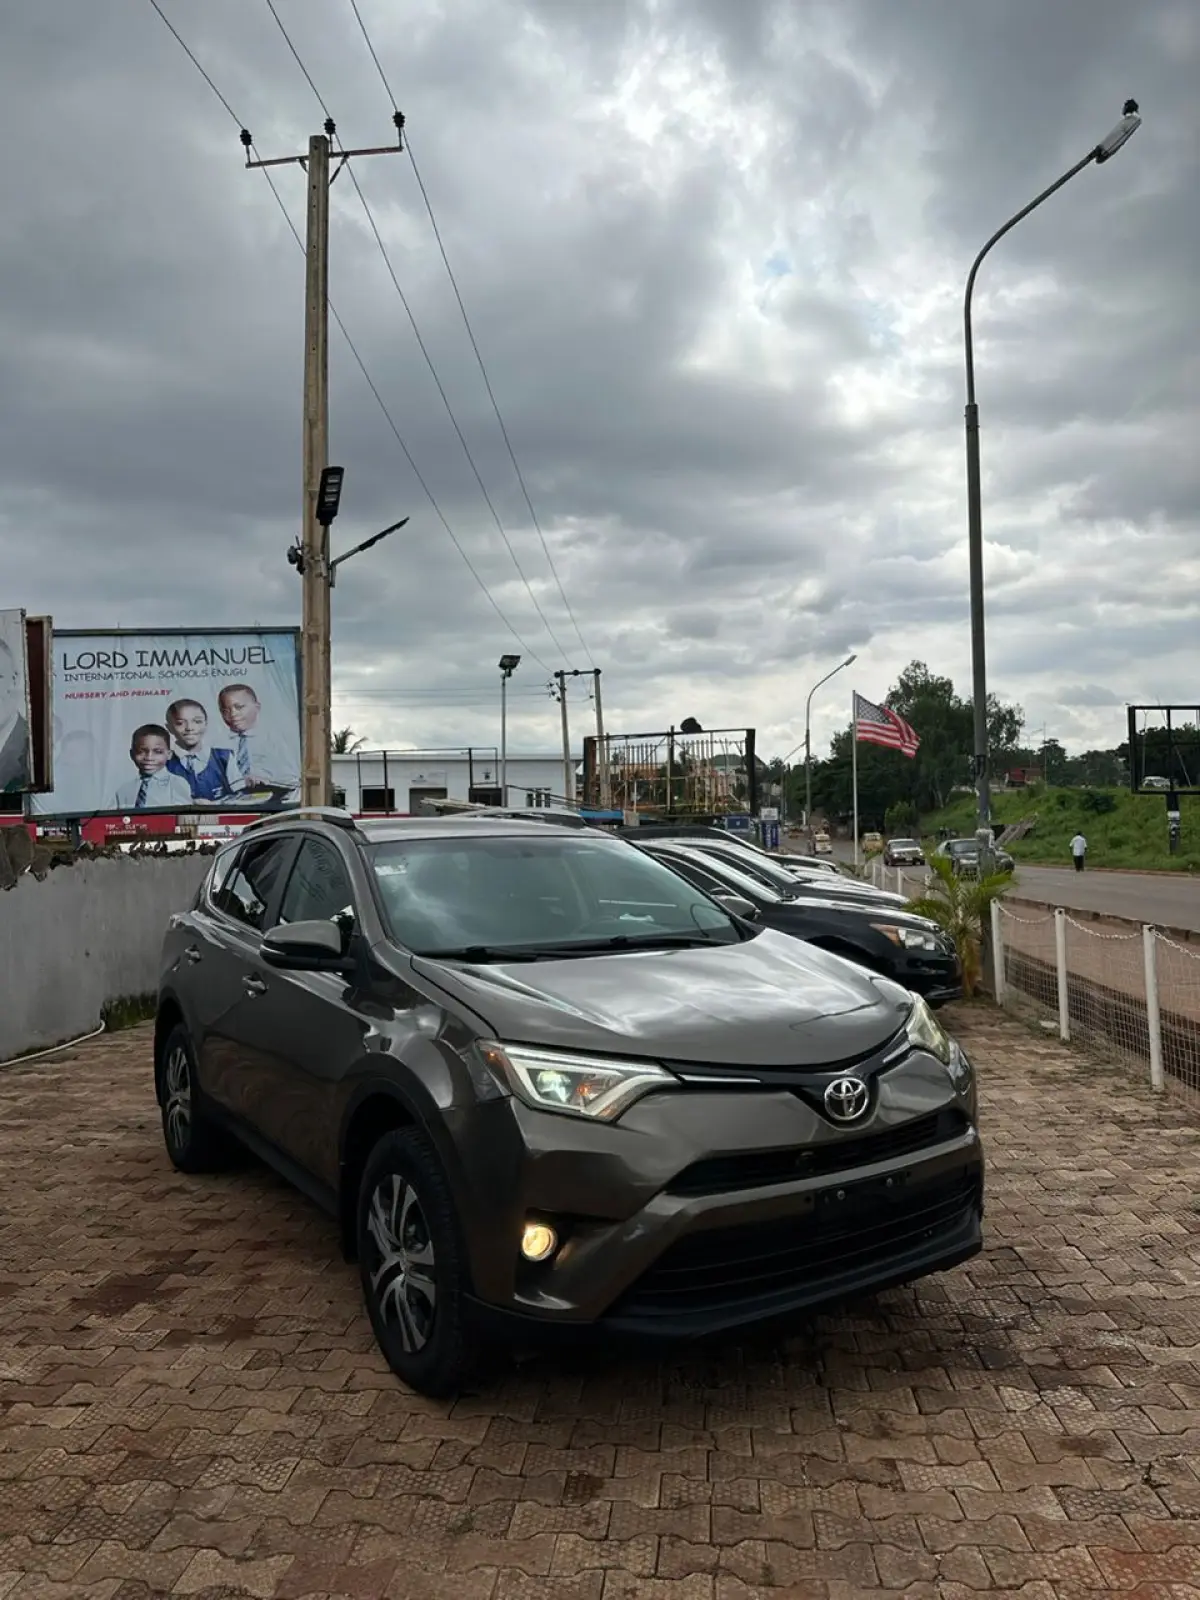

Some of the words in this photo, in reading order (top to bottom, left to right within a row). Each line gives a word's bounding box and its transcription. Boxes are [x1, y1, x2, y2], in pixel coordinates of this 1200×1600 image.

[63, 651, 128, 670] LORD
[135, 646, 275, 667] IMMANUEL
[64, 671, 155, 682] INTERNATIONAL
[158, 669, 208, 679] SCHOOLS
[211, 667, 247, 677] ENUGU
[64, 691, 107, 699] NURSERY
[109, 690, 129, 698] AND
[131, 688, 172, 697] PRIMARY
